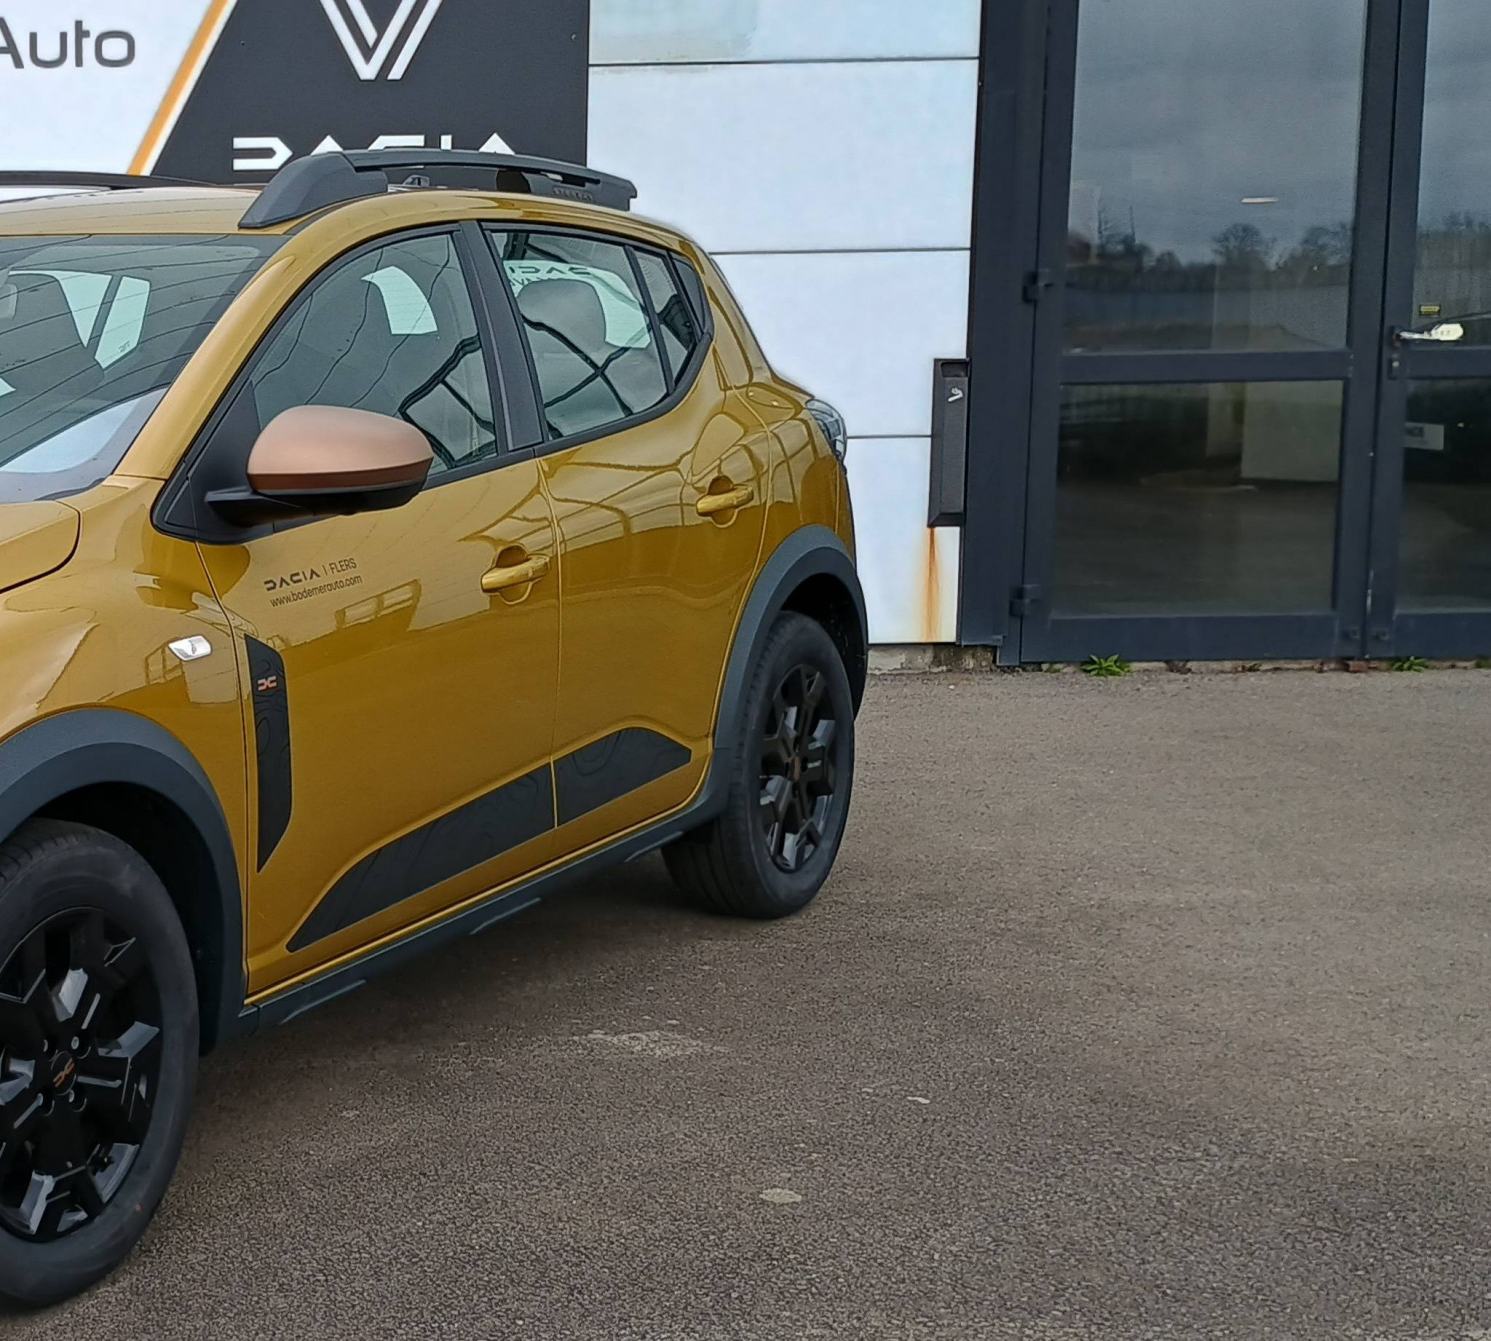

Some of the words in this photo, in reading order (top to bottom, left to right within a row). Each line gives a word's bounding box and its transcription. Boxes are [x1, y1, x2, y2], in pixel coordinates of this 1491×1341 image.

[264, 568, 320, 592] DACIA
[328, 557, 357, 575] FLERS
[270, 575, 363, 607] www.bodemerauto.com
